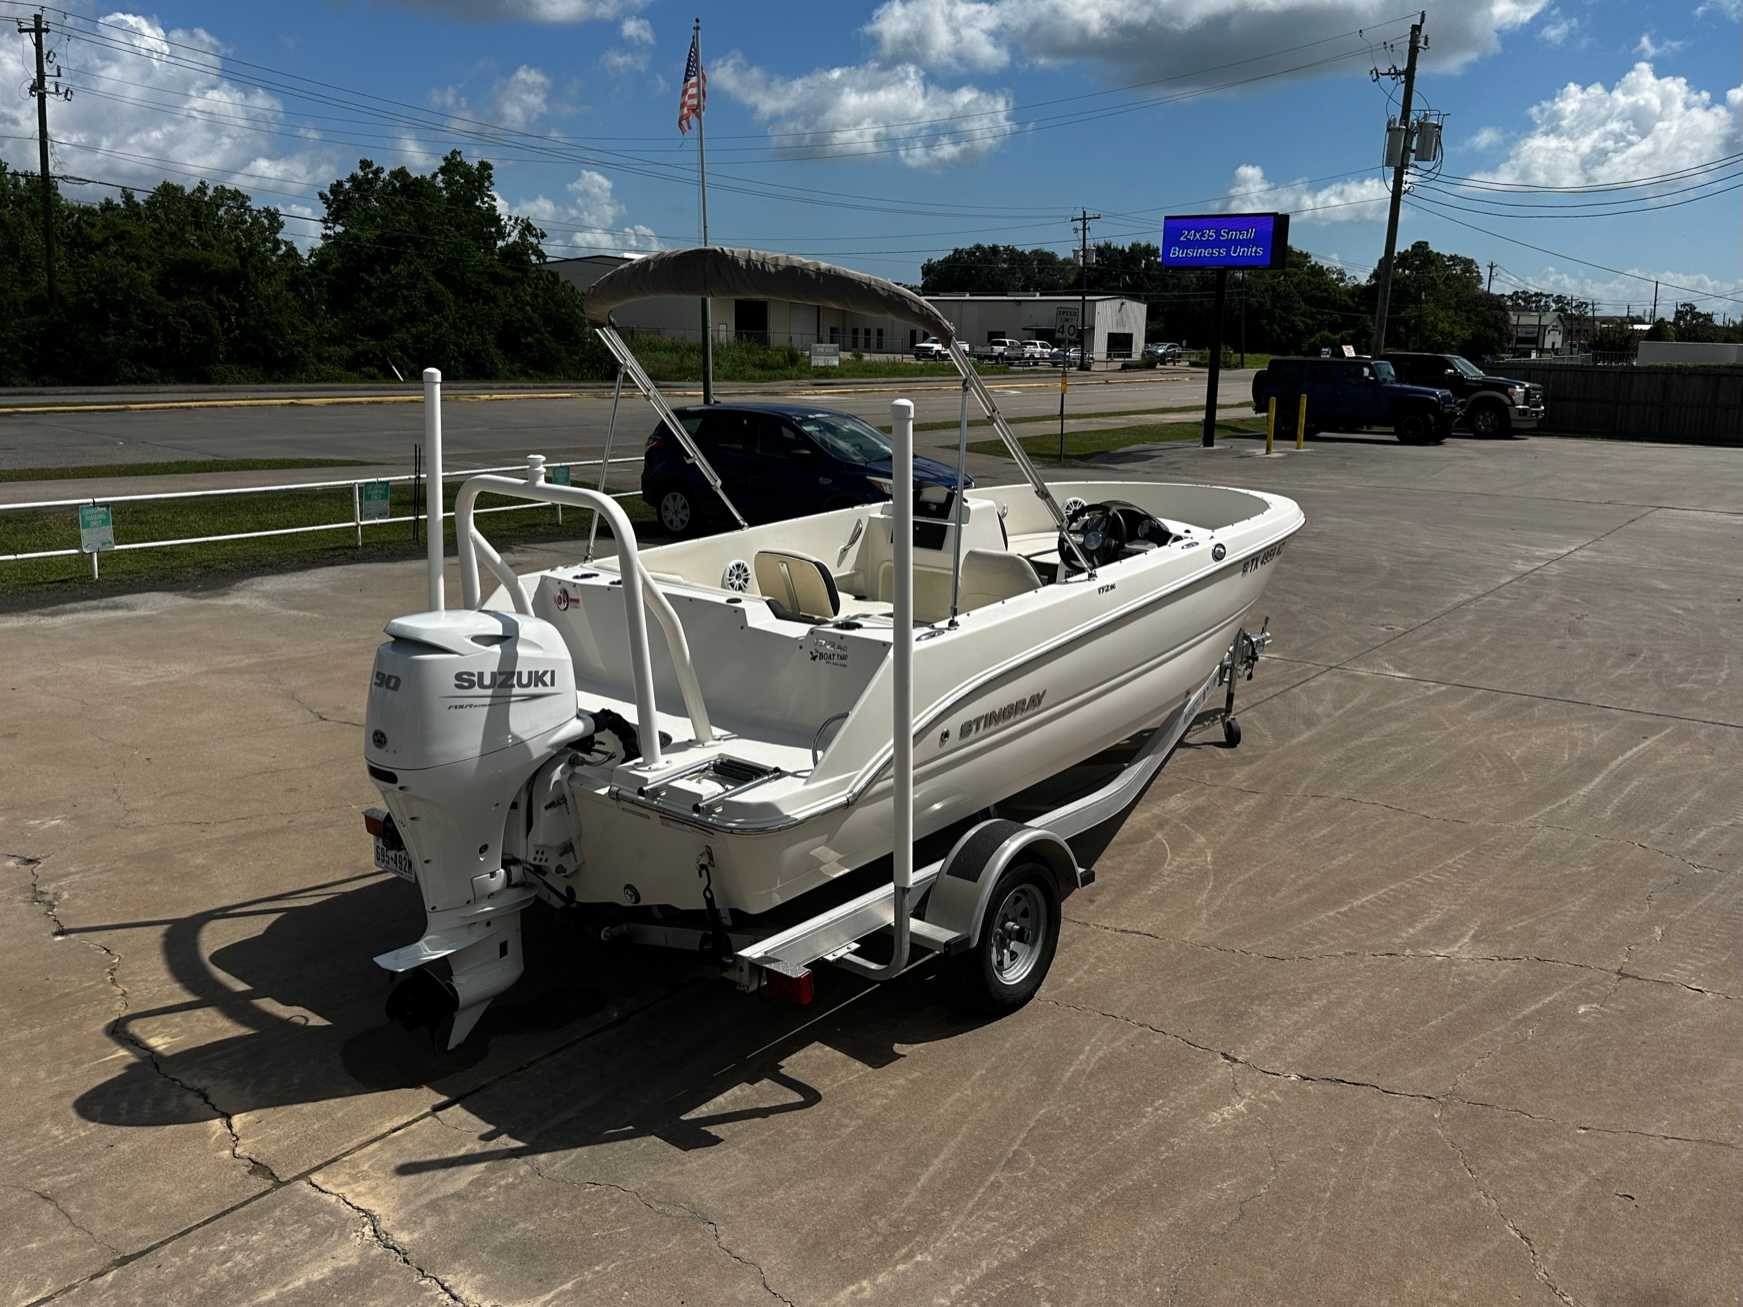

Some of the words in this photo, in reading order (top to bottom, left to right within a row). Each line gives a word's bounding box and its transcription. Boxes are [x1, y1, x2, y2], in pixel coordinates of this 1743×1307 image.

[1180, 229, 1216, 241] 24x35
[1220, 228, 1256, 240] Small
[1169, 246, 1227, 258] Business
[1230, 245, 1264, 257] Units
[1057, 324, 1077, 337] 40
[374, 671, 402, 692] 90
[454, 669, 557, 690] SUZUKI
[959, 688, 1047, 741] STINGRAY
